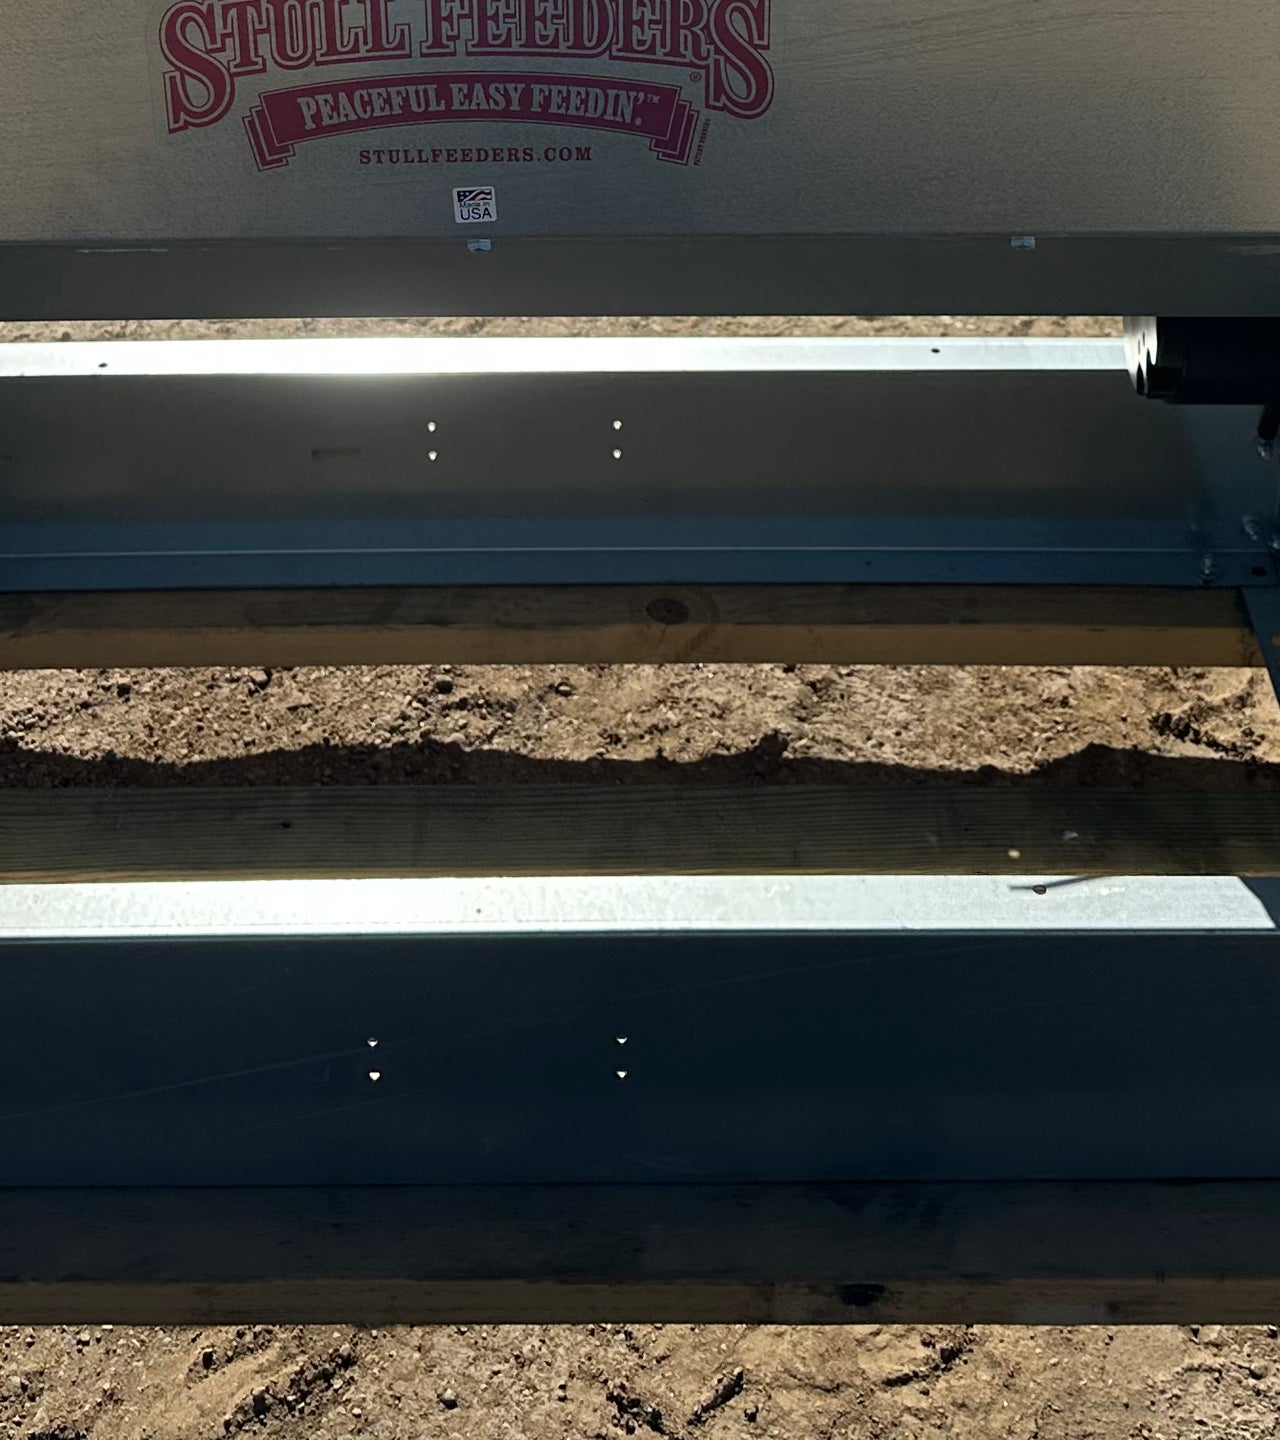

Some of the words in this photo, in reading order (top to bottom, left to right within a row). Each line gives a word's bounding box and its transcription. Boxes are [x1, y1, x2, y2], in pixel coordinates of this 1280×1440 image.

[296, 84, 446, 130] PEACEFUL
[449, 82, 526, 112] EASY
[358, 146, 593, 165] STULLFEEDERS.COM
[460, 207, 492, 221] USA
